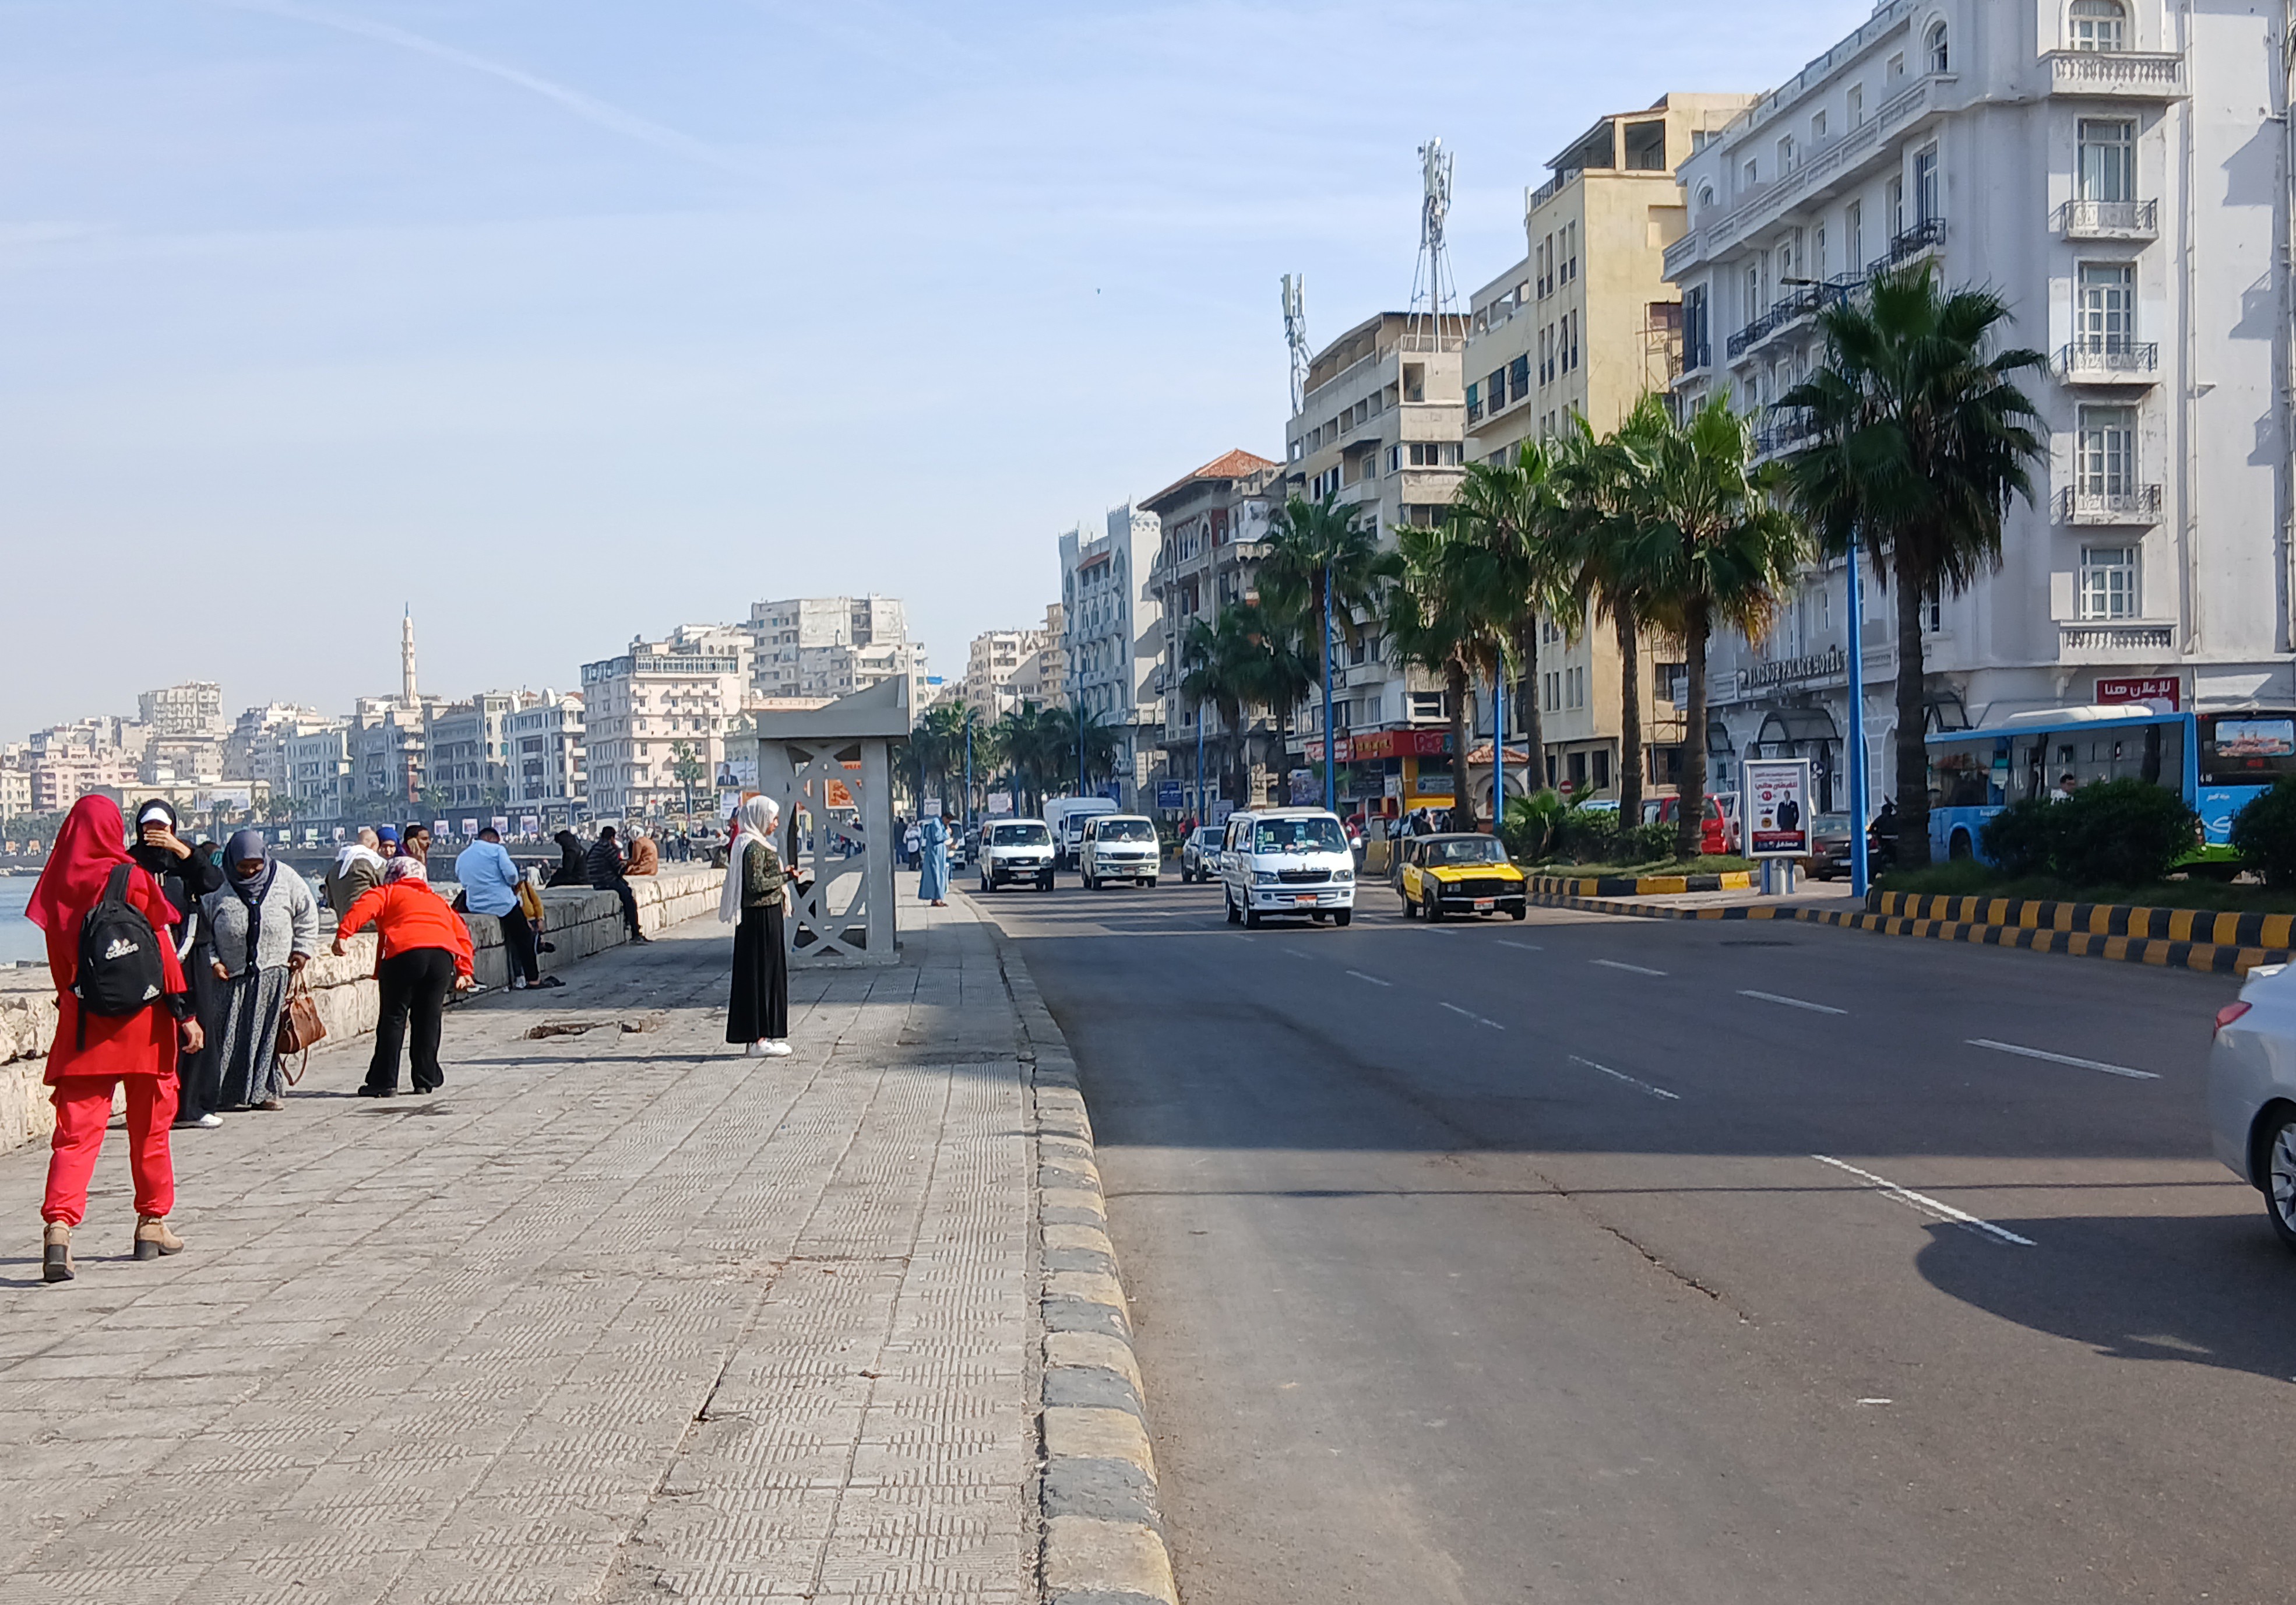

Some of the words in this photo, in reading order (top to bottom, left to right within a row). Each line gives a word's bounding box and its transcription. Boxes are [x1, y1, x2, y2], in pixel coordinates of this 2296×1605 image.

[1782, 657, 1811, 681] PALACE
[1813, 652, 1840, 674] HOTEL
[2105, 684, 2127, 695] هنا
[2130, 680, 2171, 698] للإعلان
[105, 943, 139, 960] adidas
